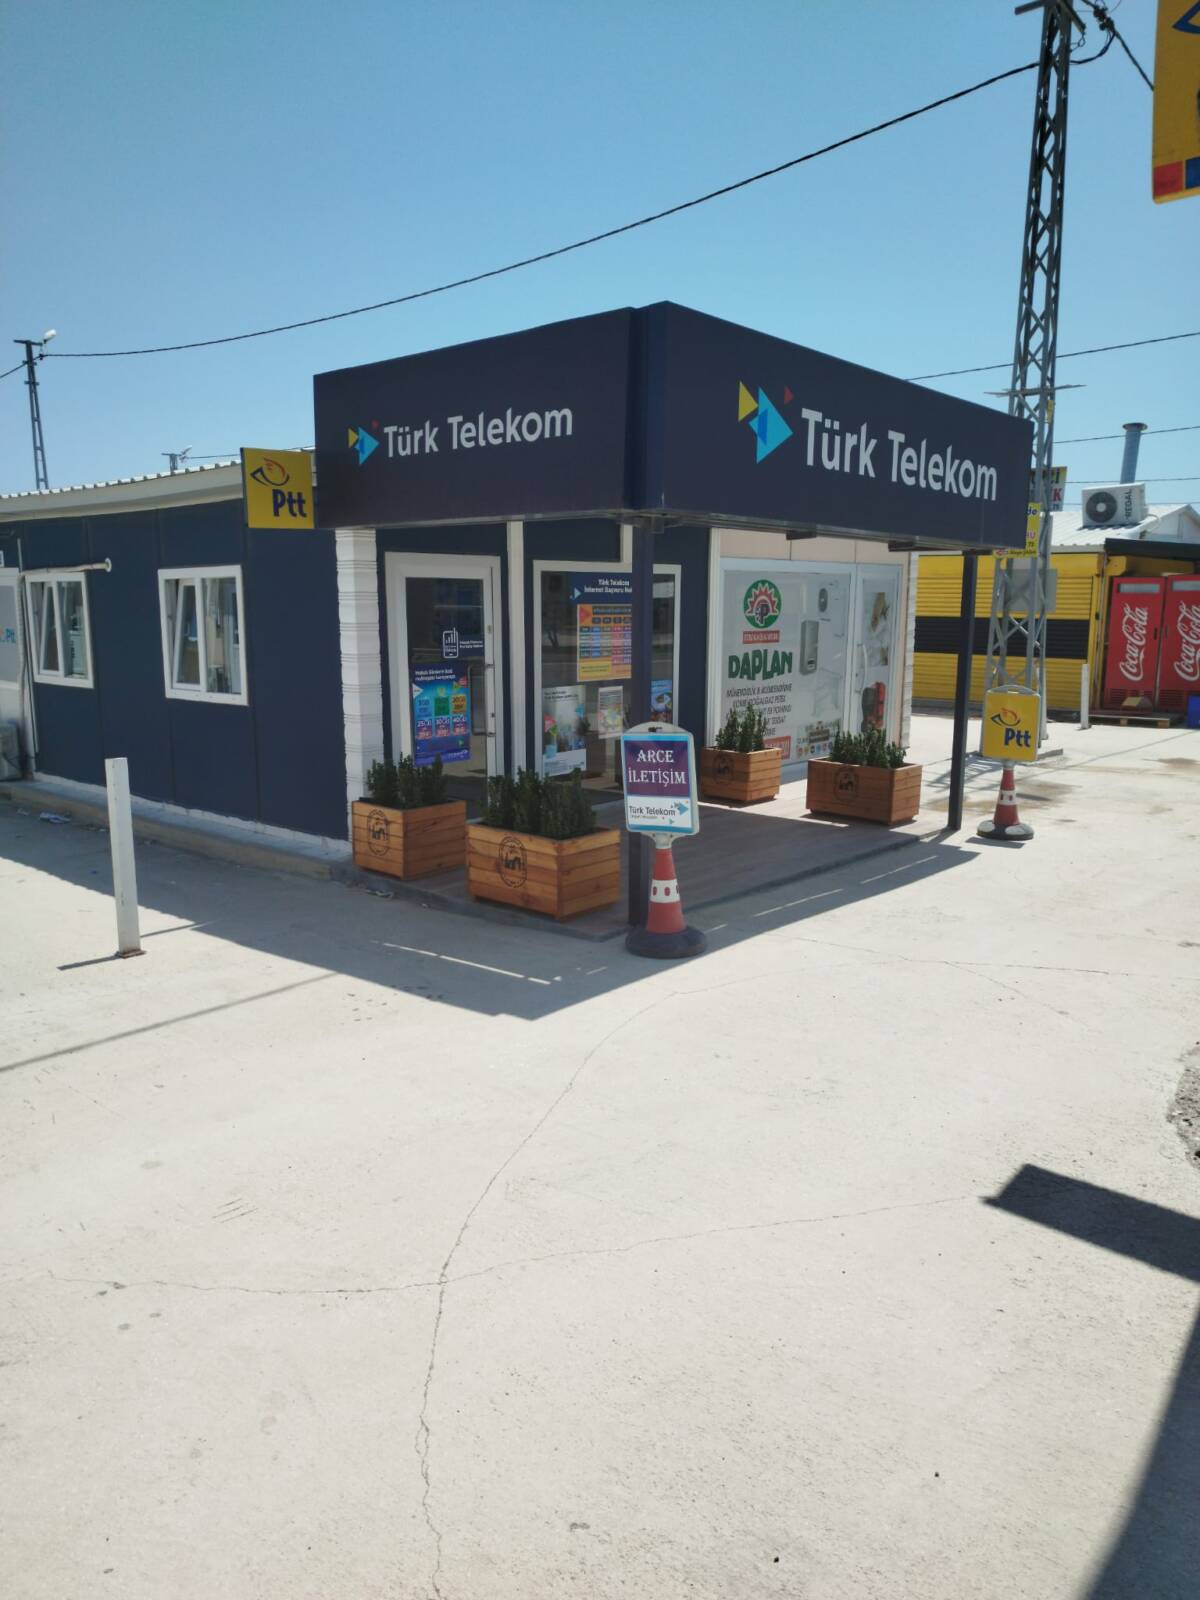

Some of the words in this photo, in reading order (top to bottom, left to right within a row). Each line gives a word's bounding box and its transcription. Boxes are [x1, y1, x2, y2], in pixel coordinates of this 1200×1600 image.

[384, 420, 439, 458] Türk
[447, 407, 573, 450] Telekom
[801, 407, 877, 478] Türk
[888, 430, 997, 501] Telekom
[272, 489, 307, 518] Ptt
[1119, 602, 1148, 681] Coca-Cola
[728, 649, 793, 681] DAPLAN
[1004, 728, 1031, 747] Ptt
[636, 749, 675, 763] ARCE
[628, 767, 687, 787] İLETİŞİM
[629, 805, 644, 815] Türk
[645, 806, 676, 817] Telekom
